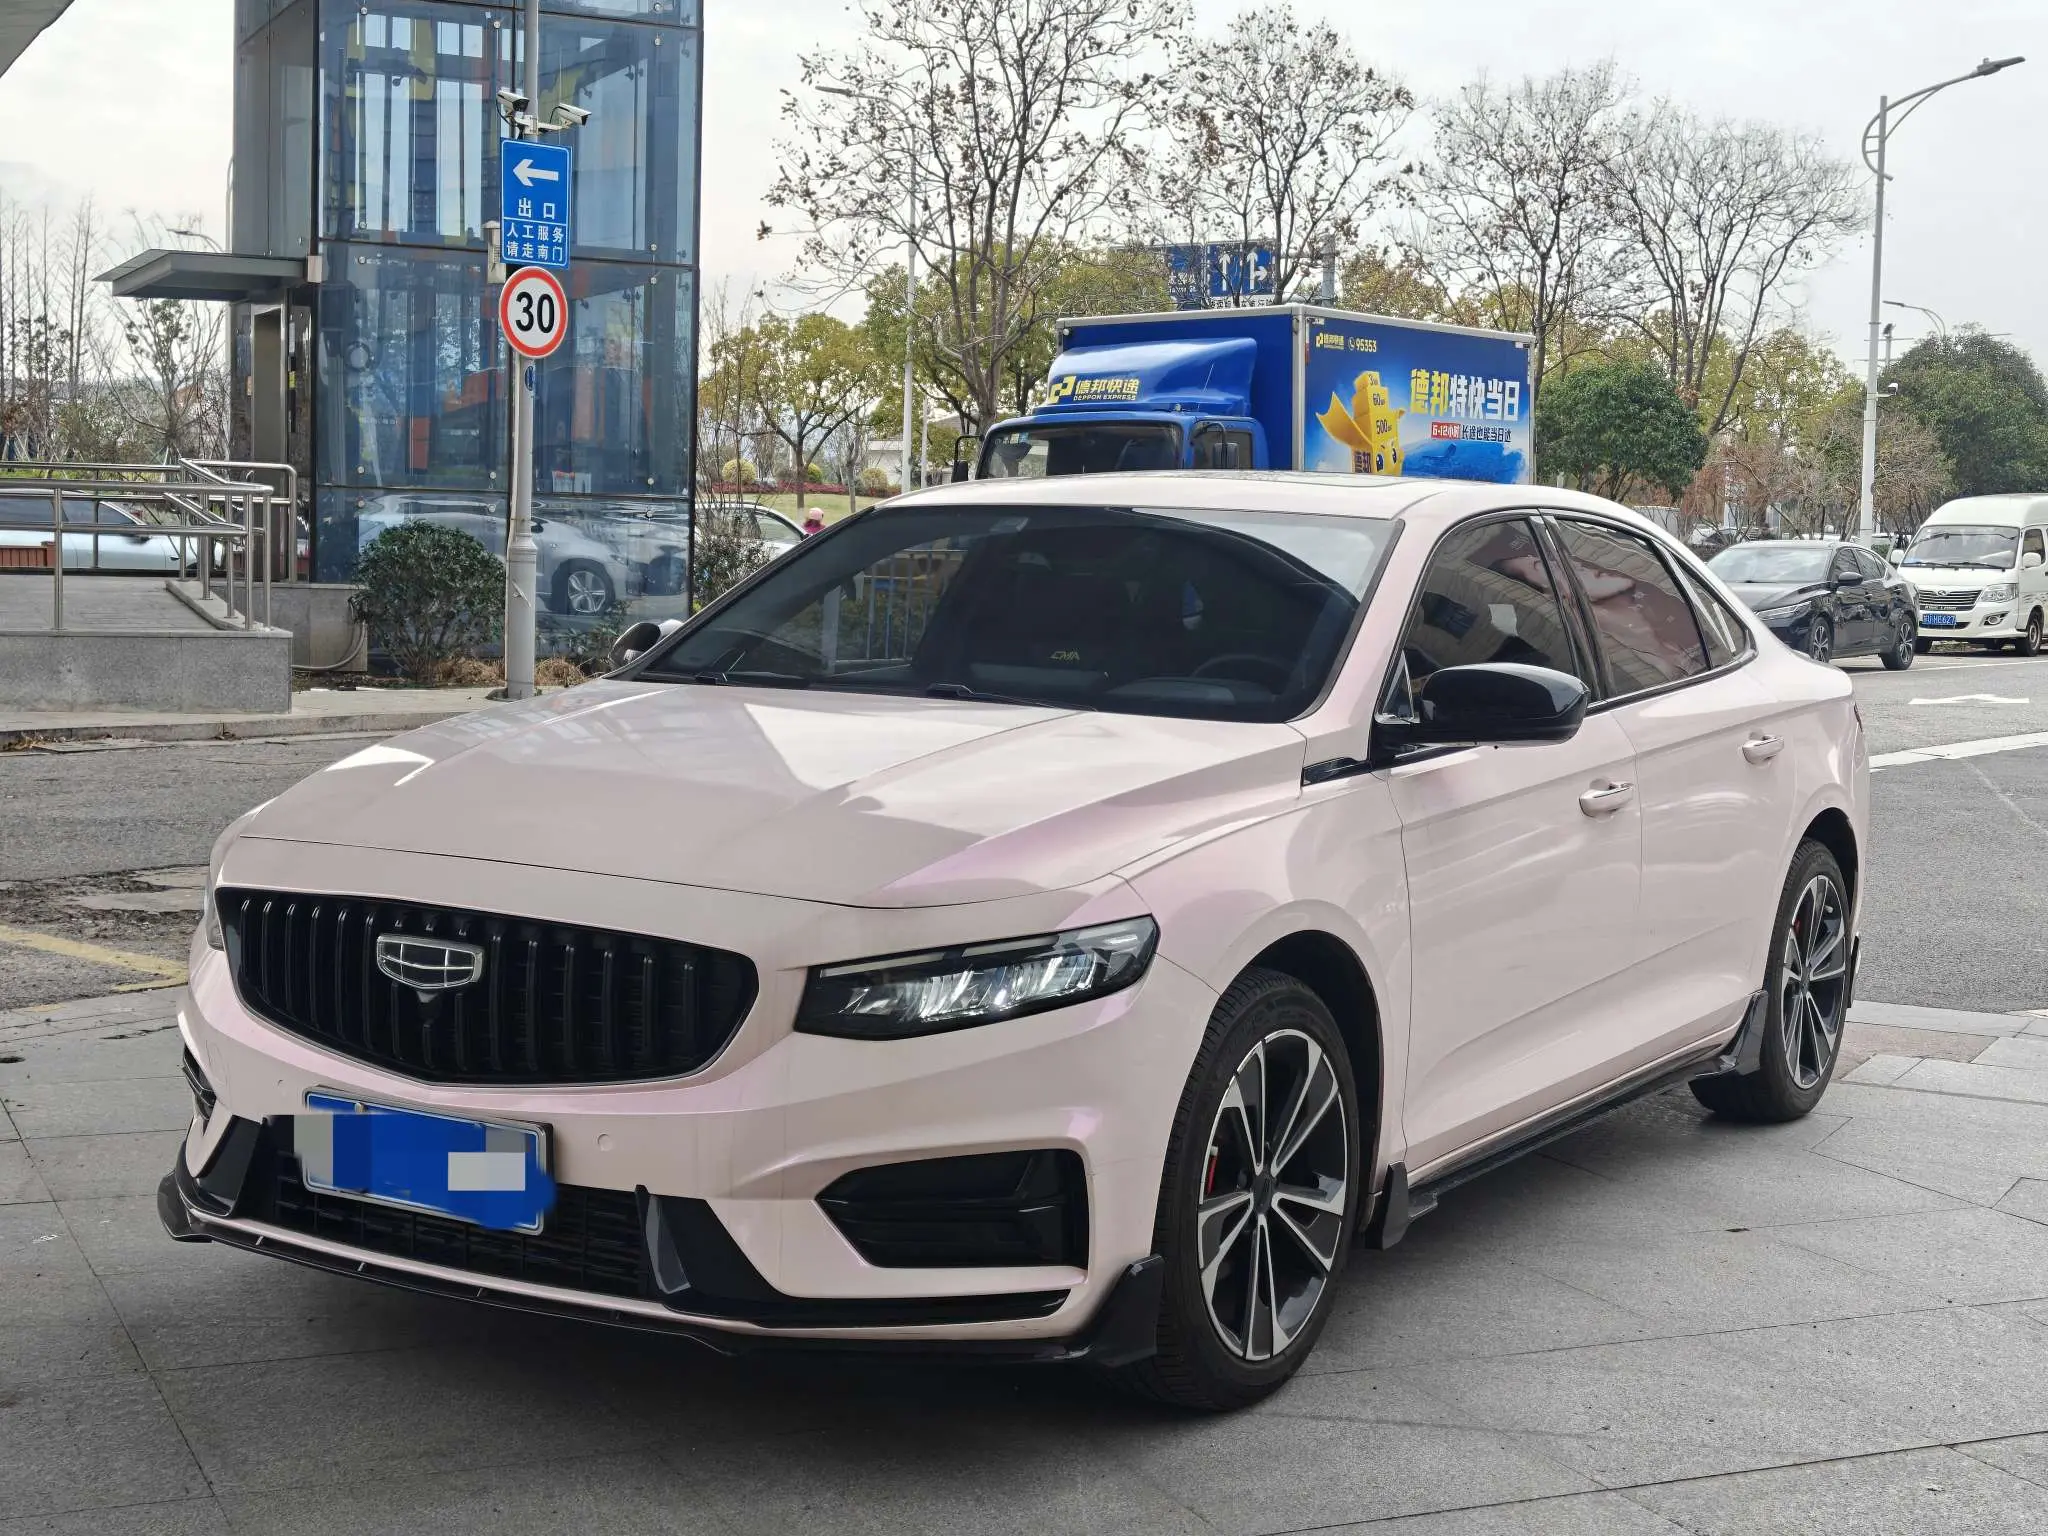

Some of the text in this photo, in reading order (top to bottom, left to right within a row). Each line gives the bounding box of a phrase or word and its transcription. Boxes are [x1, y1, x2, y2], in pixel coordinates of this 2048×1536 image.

[518, 198, 556, 220] 出口
[508, 223, 564, 243] 人工服务
[507, 241, 563, 262] 请走南门
[515, 291, 555, 334] 30
[1356, 337, 1377, 352] 95353
[1075, 379, 1140, 394] 德邦快递
[1410, 368, 1520, 421] 德邦特快当日
[1103, 393, 1137, 401] EXPRESS
